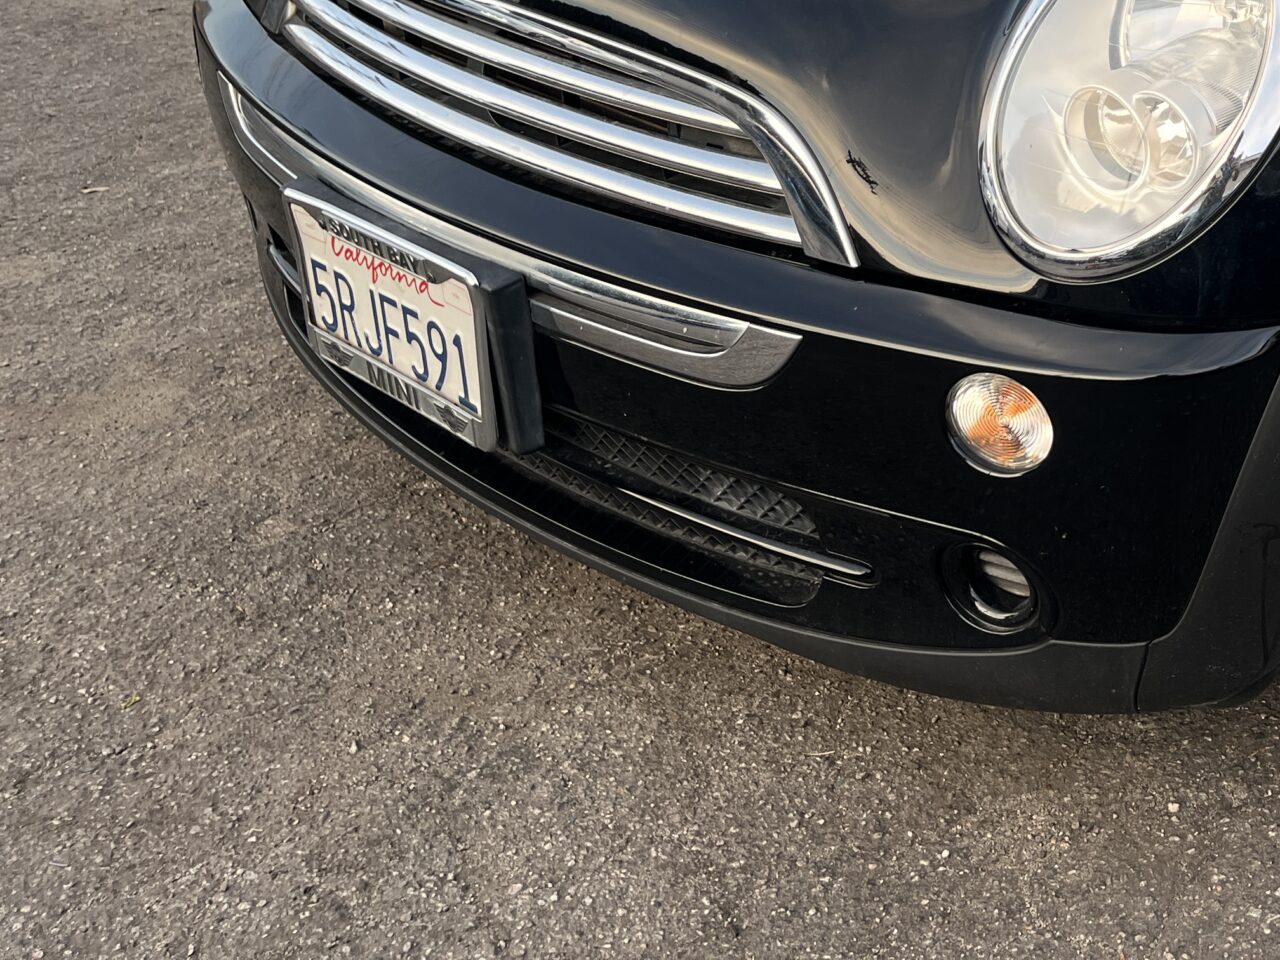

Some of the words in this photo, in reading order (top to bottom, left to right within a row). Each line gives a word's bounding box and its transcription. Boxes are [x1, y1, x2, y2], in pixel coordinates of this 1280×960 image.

[328, 219, 381, 259] SOUTH
[331, 235, 445, 308] California
[310, 257, 479, 414] 5RJF591
[366, 359, 421, 412] MINI
